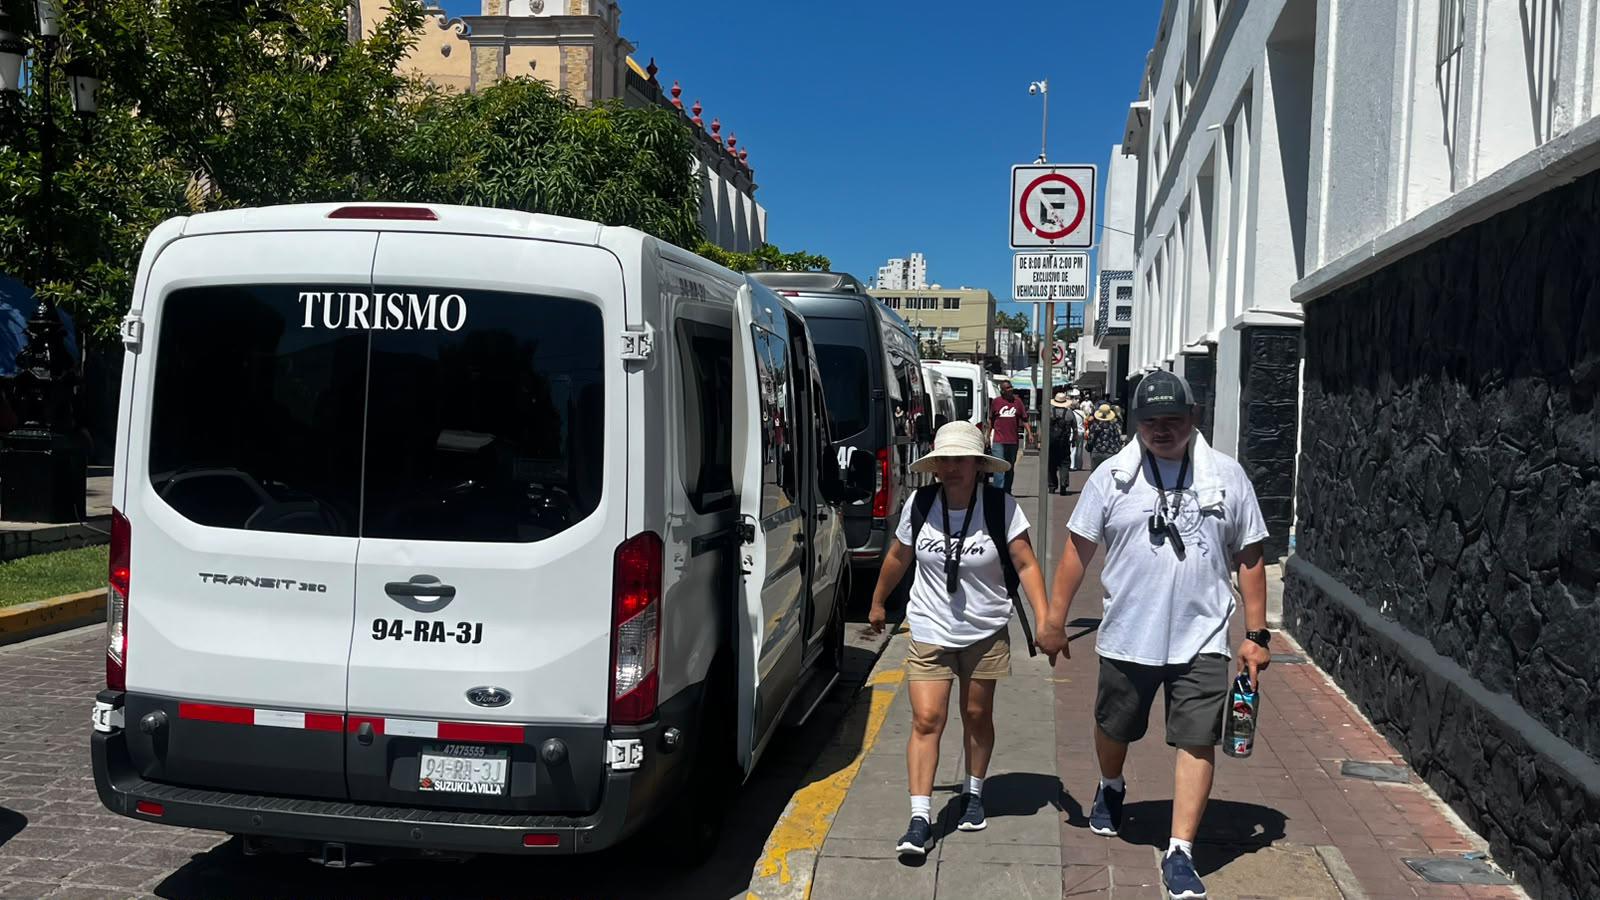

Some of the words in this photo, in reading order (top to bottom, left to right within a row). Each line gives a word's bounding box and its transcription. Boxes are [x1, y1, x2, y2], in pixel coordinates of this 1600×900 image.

[1019, 257, 1027, 269] DE
[1028, 257, 1041, 269] 8:00
[1053, 257, 1058, 269] A
[1059, 257, 1072, 269] 2:00
[1073, 257, 1083, 269] PM
[1032, 271, 1060, 282] EXCLUSIVO
[1061, 271, 1069, 282] DE
[1016, 285, 1048, 297] VEHICULOS
[1049, 285, 1057, 297] DE
[1058, 285, 1085, 297] TURISMO
[299, 292, 467, 332] TURISMO
[198, 572, 297, 590] TRANSIT
[298, 582, 327, 593] 350
[371, 618, 483, 644] 94-RA-3J
[475, 695, 501, 703] Ford
[443, 744, 486, 757] 47475555
[426, 758, 502, 781] 94-RA-3J
